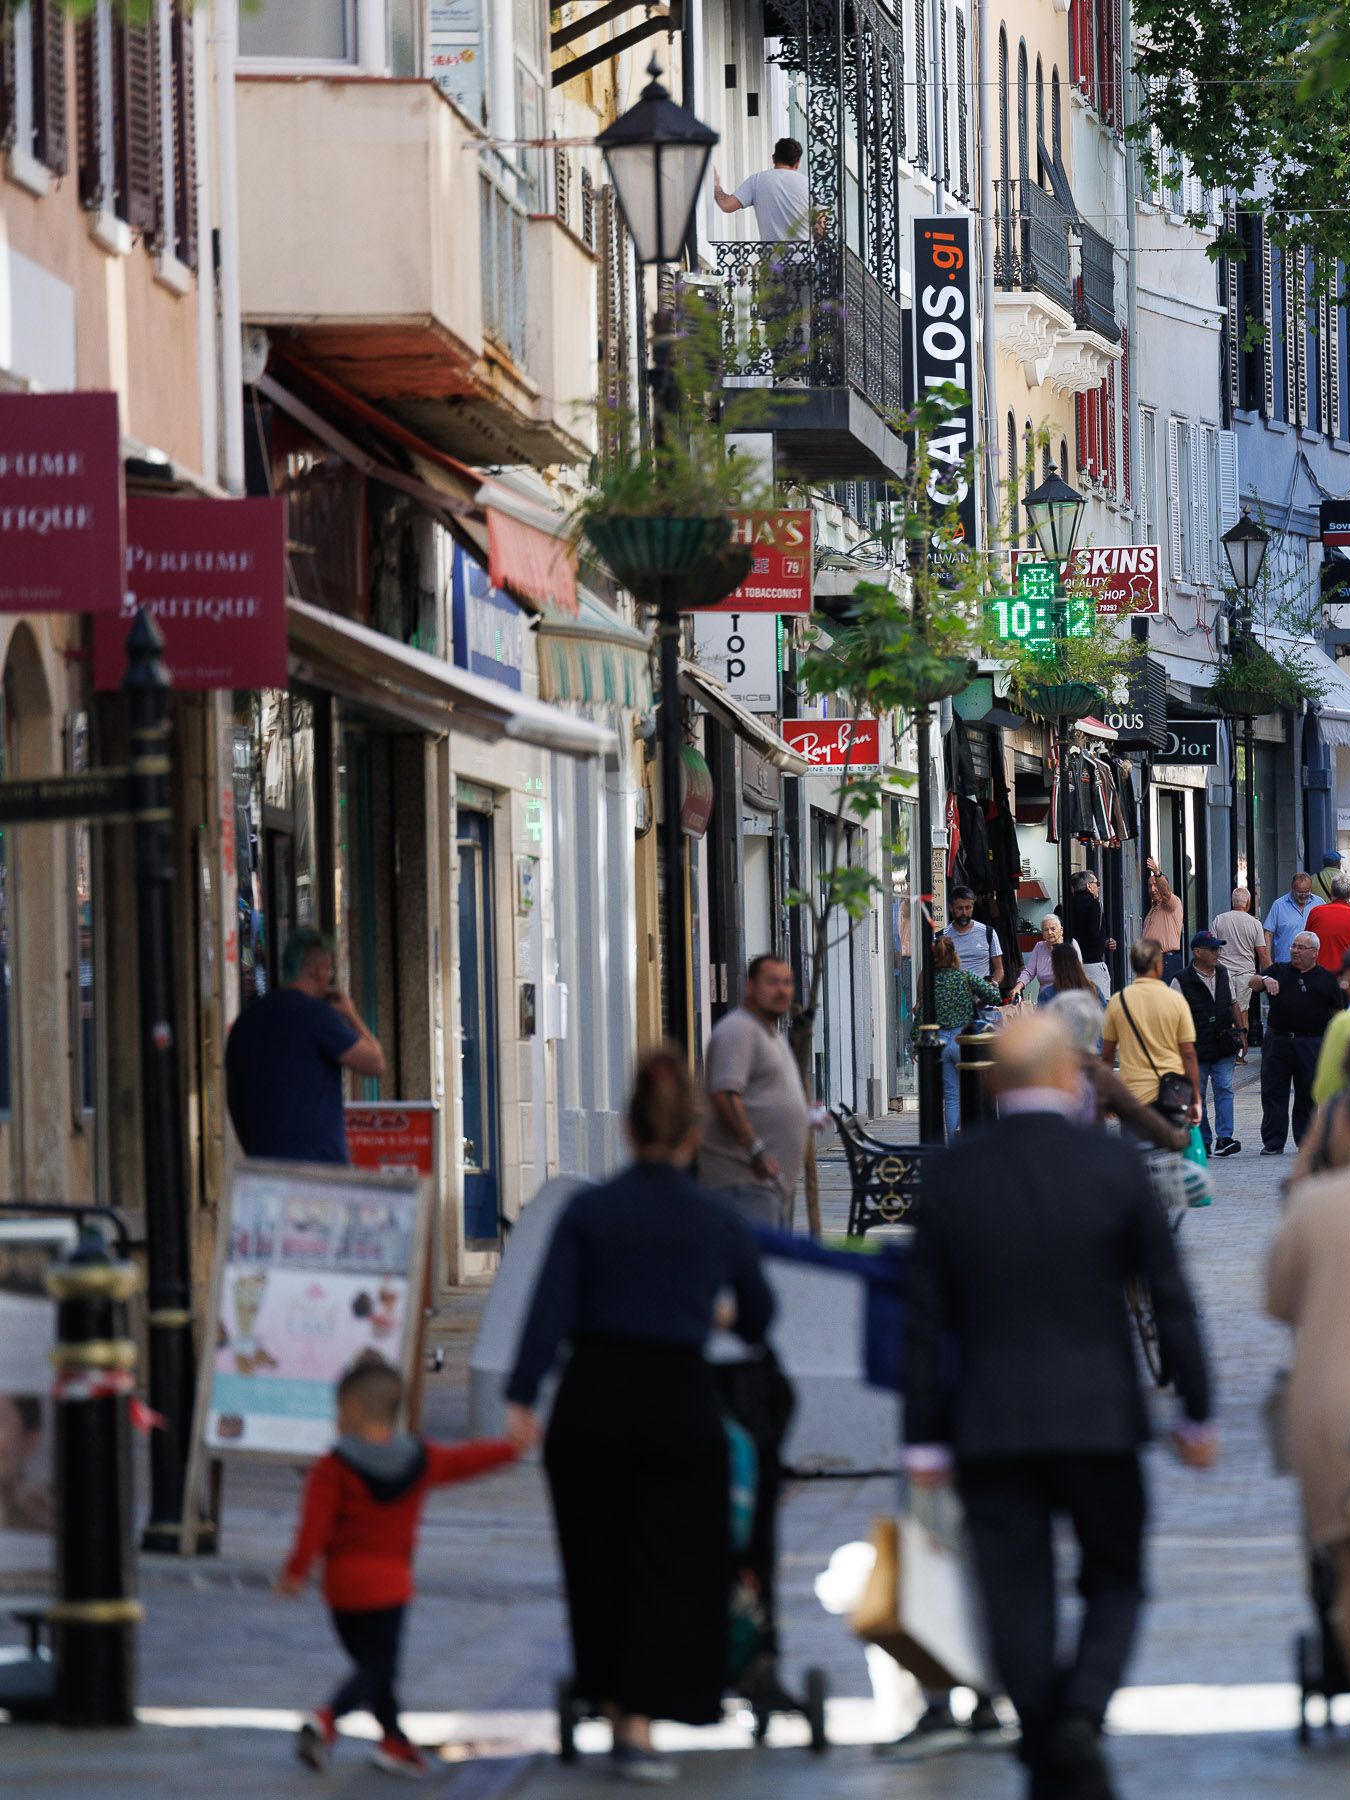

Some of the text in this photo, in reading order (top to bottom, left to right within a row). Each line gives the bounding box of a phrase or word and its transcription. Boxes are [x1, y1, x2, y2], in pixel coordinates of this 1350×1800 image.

[124, 545, 254, 572] PERFUME
[752, 558, 770, 574] EE
[1075, 549, 1155, 575] SKINS
[786, 562, 800, 574] 79
[745, 588, 802, 599] TOBACCONIST
[1098, 589, 1126, 600] SHOP
[1103, 714, 1144, 729] TOUS
[789, 723, 872, 763] Ray-Ban
[1155, 731, 1211, 756] Dior
